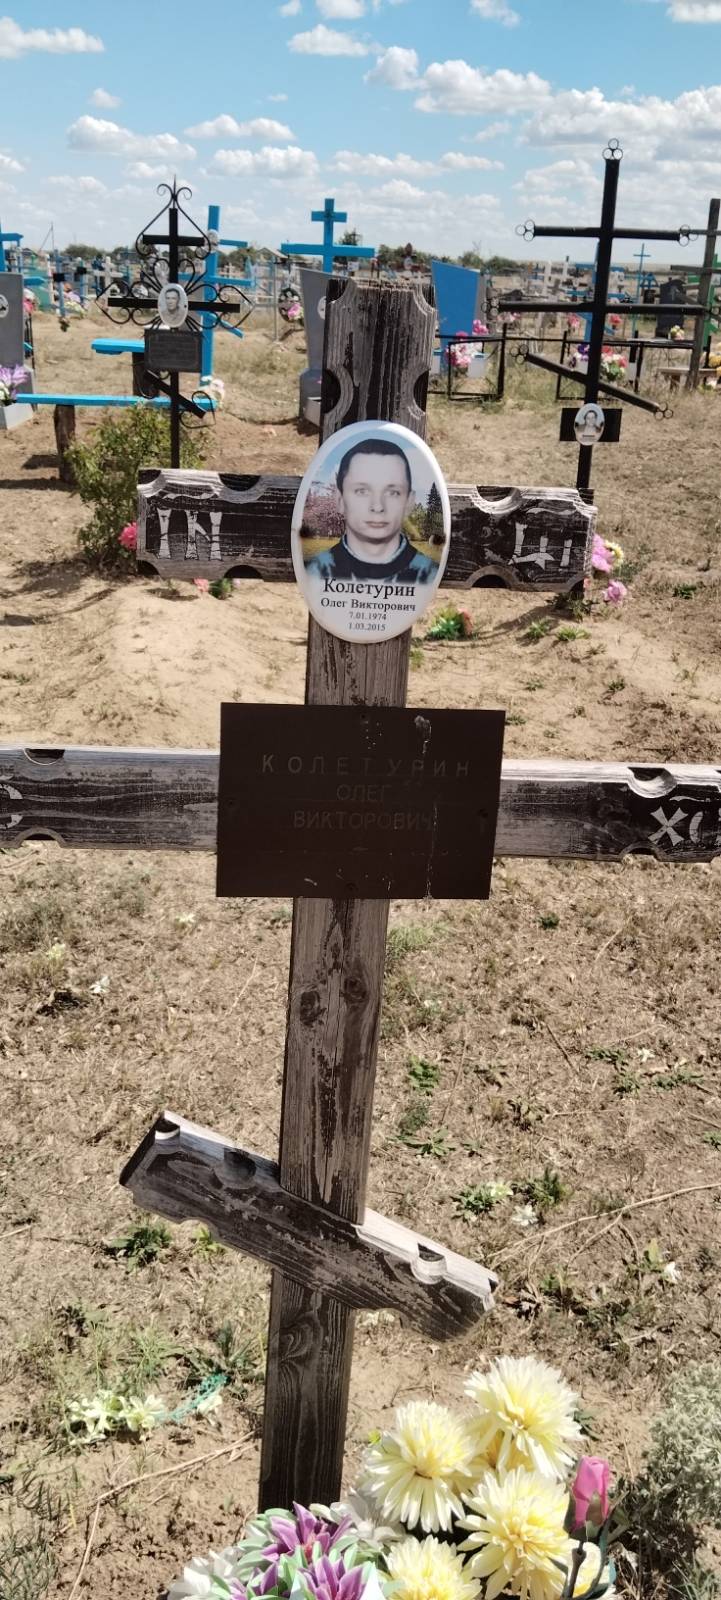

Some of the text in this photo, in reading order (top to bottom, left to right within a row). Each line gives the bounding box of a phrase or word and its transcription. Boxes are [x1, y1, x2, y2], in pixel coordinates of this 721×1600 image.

[323, 578, 416, 599] Колетурин
[320, 597, 416, 613] Олег Викторович
[348, 611, 387, 621] 7.01.1974
[348, 622, 386, 632] 1.03.2015
[261, 753, 471, 777] КОЛЕТУРИН
[336, 783, 392, 803] ОЛЕГ
[293, 809, 433, 831] ВИКТОРОВИЧ
